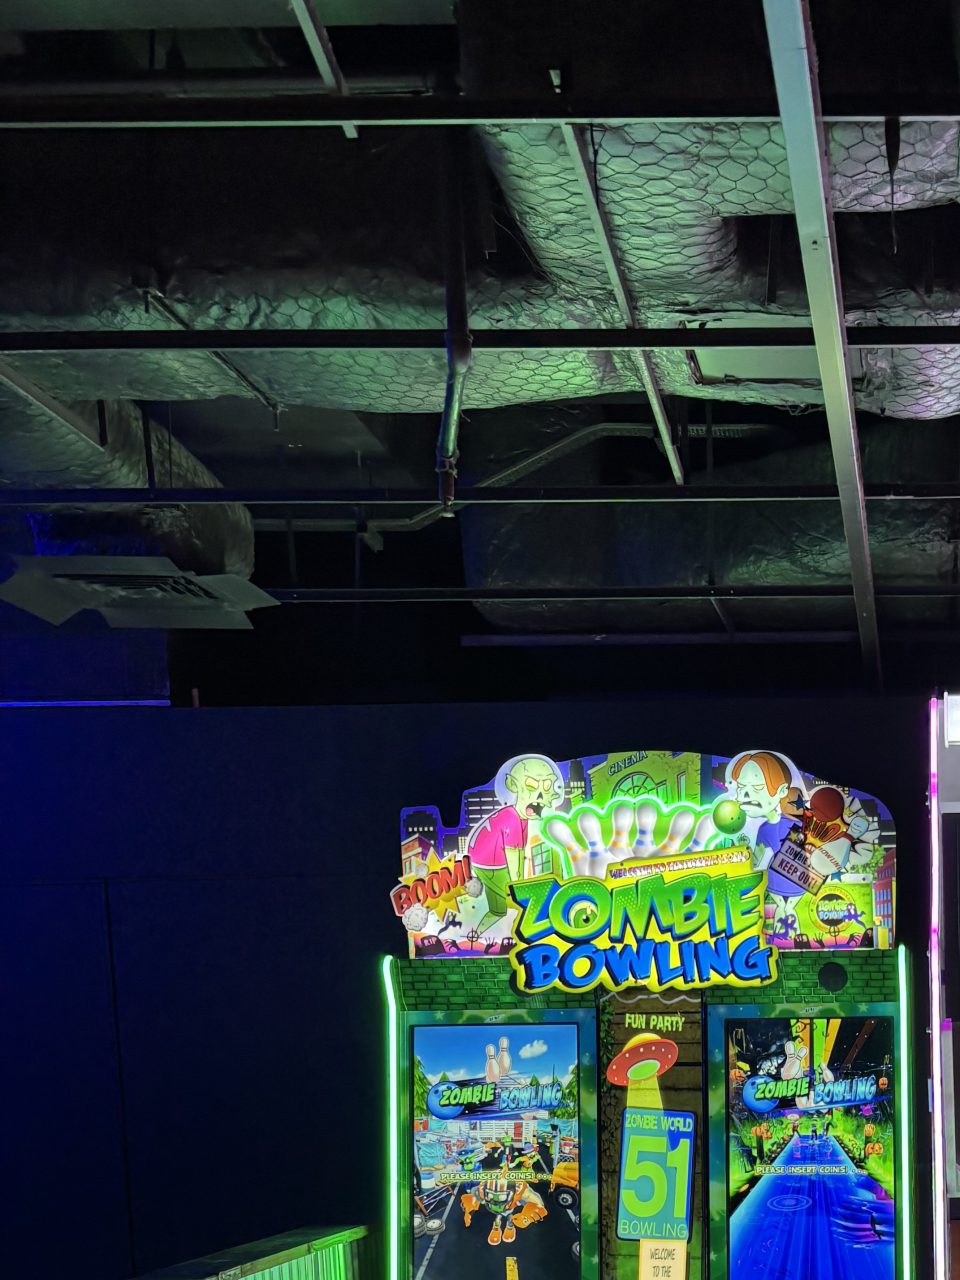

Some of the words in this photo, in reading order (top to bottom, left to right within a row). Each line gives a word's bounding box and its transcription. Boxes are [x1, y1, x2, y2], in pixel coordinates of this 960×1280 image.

[607, 750, 649, 777] CINEMA
[391, 855, 472, 917] BOOM!
[777, 859, 800, 878] KEEP
[798, 870, 818, 890] OUT!
[507, 872, 766, 943] ZOMBIE
[516, 935, 774, 990] BOWLING
[625, 1013, 646, 1030] FUN
[649, 1014, 685, 1032] PARTY
[439, 1081, 497, 1107] ZOMBIE
[499, 1081, 563, 1110] BOWLING
[754, 1076, 810, 1100] ZOMBIE
[813, 1075, 877, 1104] BOWLING
[660, 1115, 694, 1133] WORLD
[440, 1172, 470, 1181] PLEASE
[621, 1135, 689, 1218] 51
[755, 1165, 785, 1175] PLEASE
[788, 1165, 817, 1174] INSERT
[620, 1220, 687, 1238] BOWLING
[650, 1248, 676, 1260] WELCOME
[652, 1265, 661, 1278] TO
[661, 1265, 672, 1278] THE
